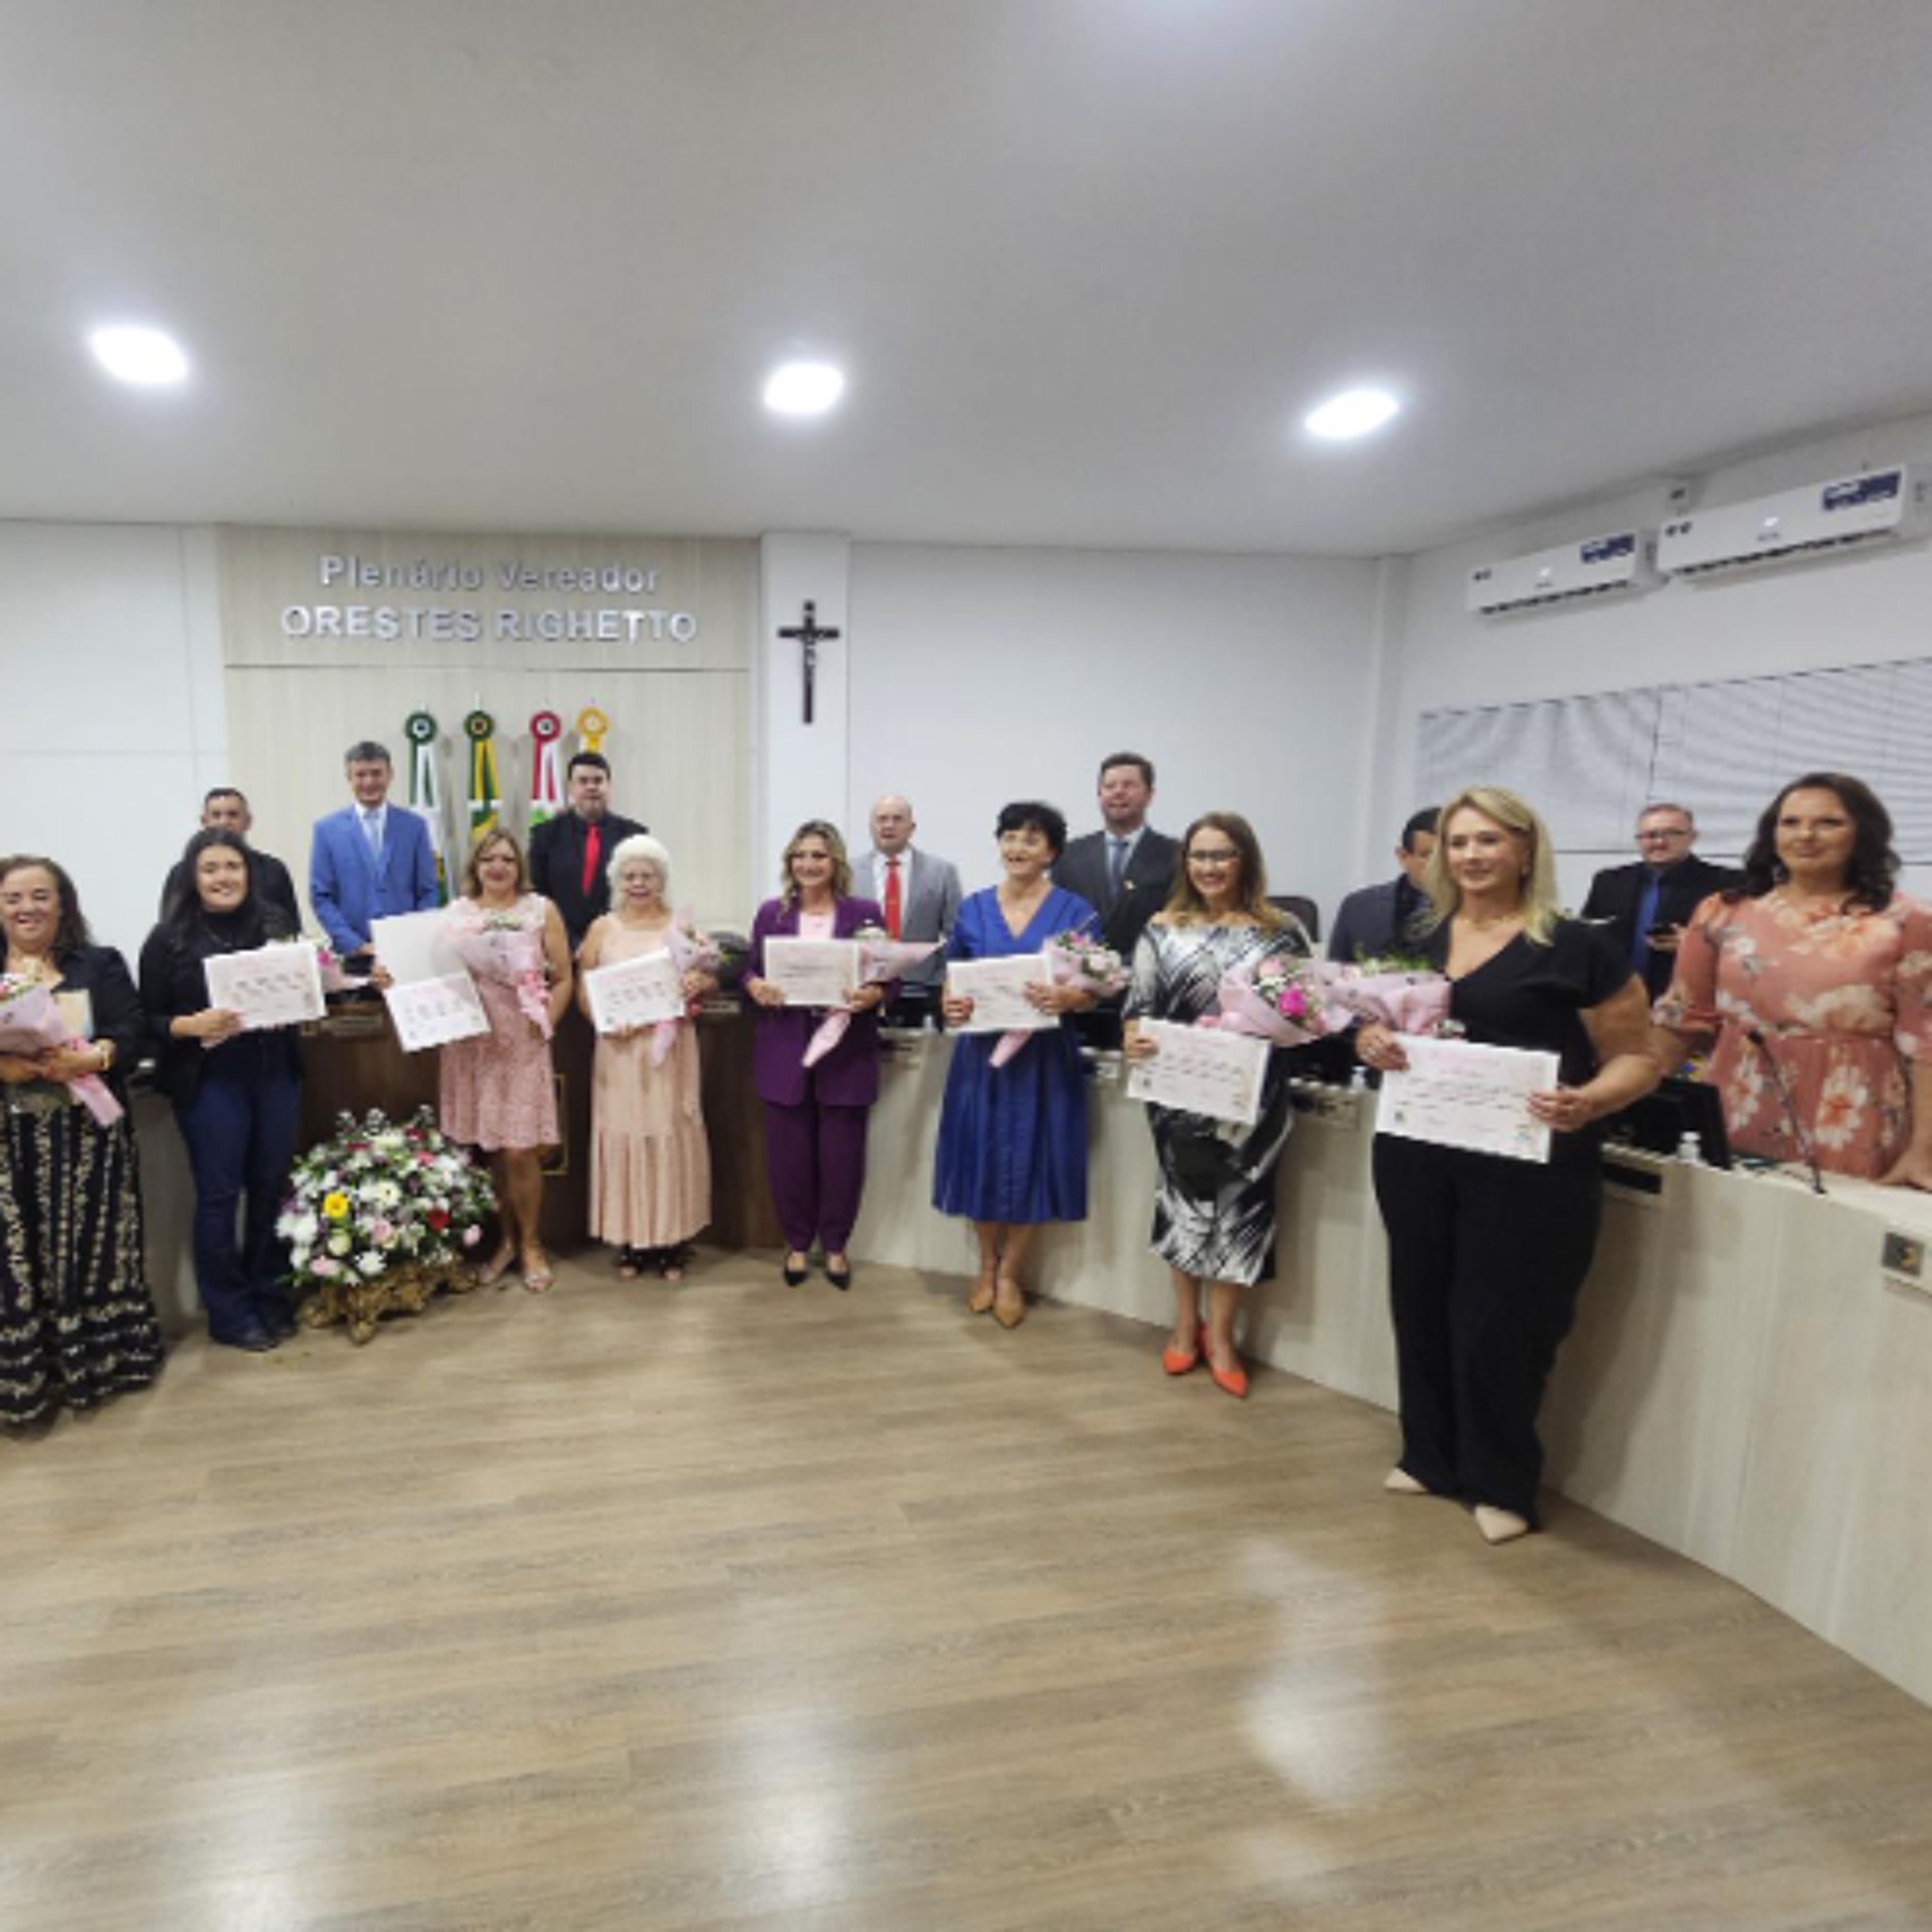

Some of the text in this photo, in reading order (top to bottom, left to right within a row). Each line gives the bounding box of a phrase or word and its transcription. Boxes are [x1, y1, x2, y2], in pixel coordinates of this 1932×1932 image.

[321, 555, 659, 593] Plenário Vereador
[282, 605, 697, 644] ORESTES RIGHETTO
